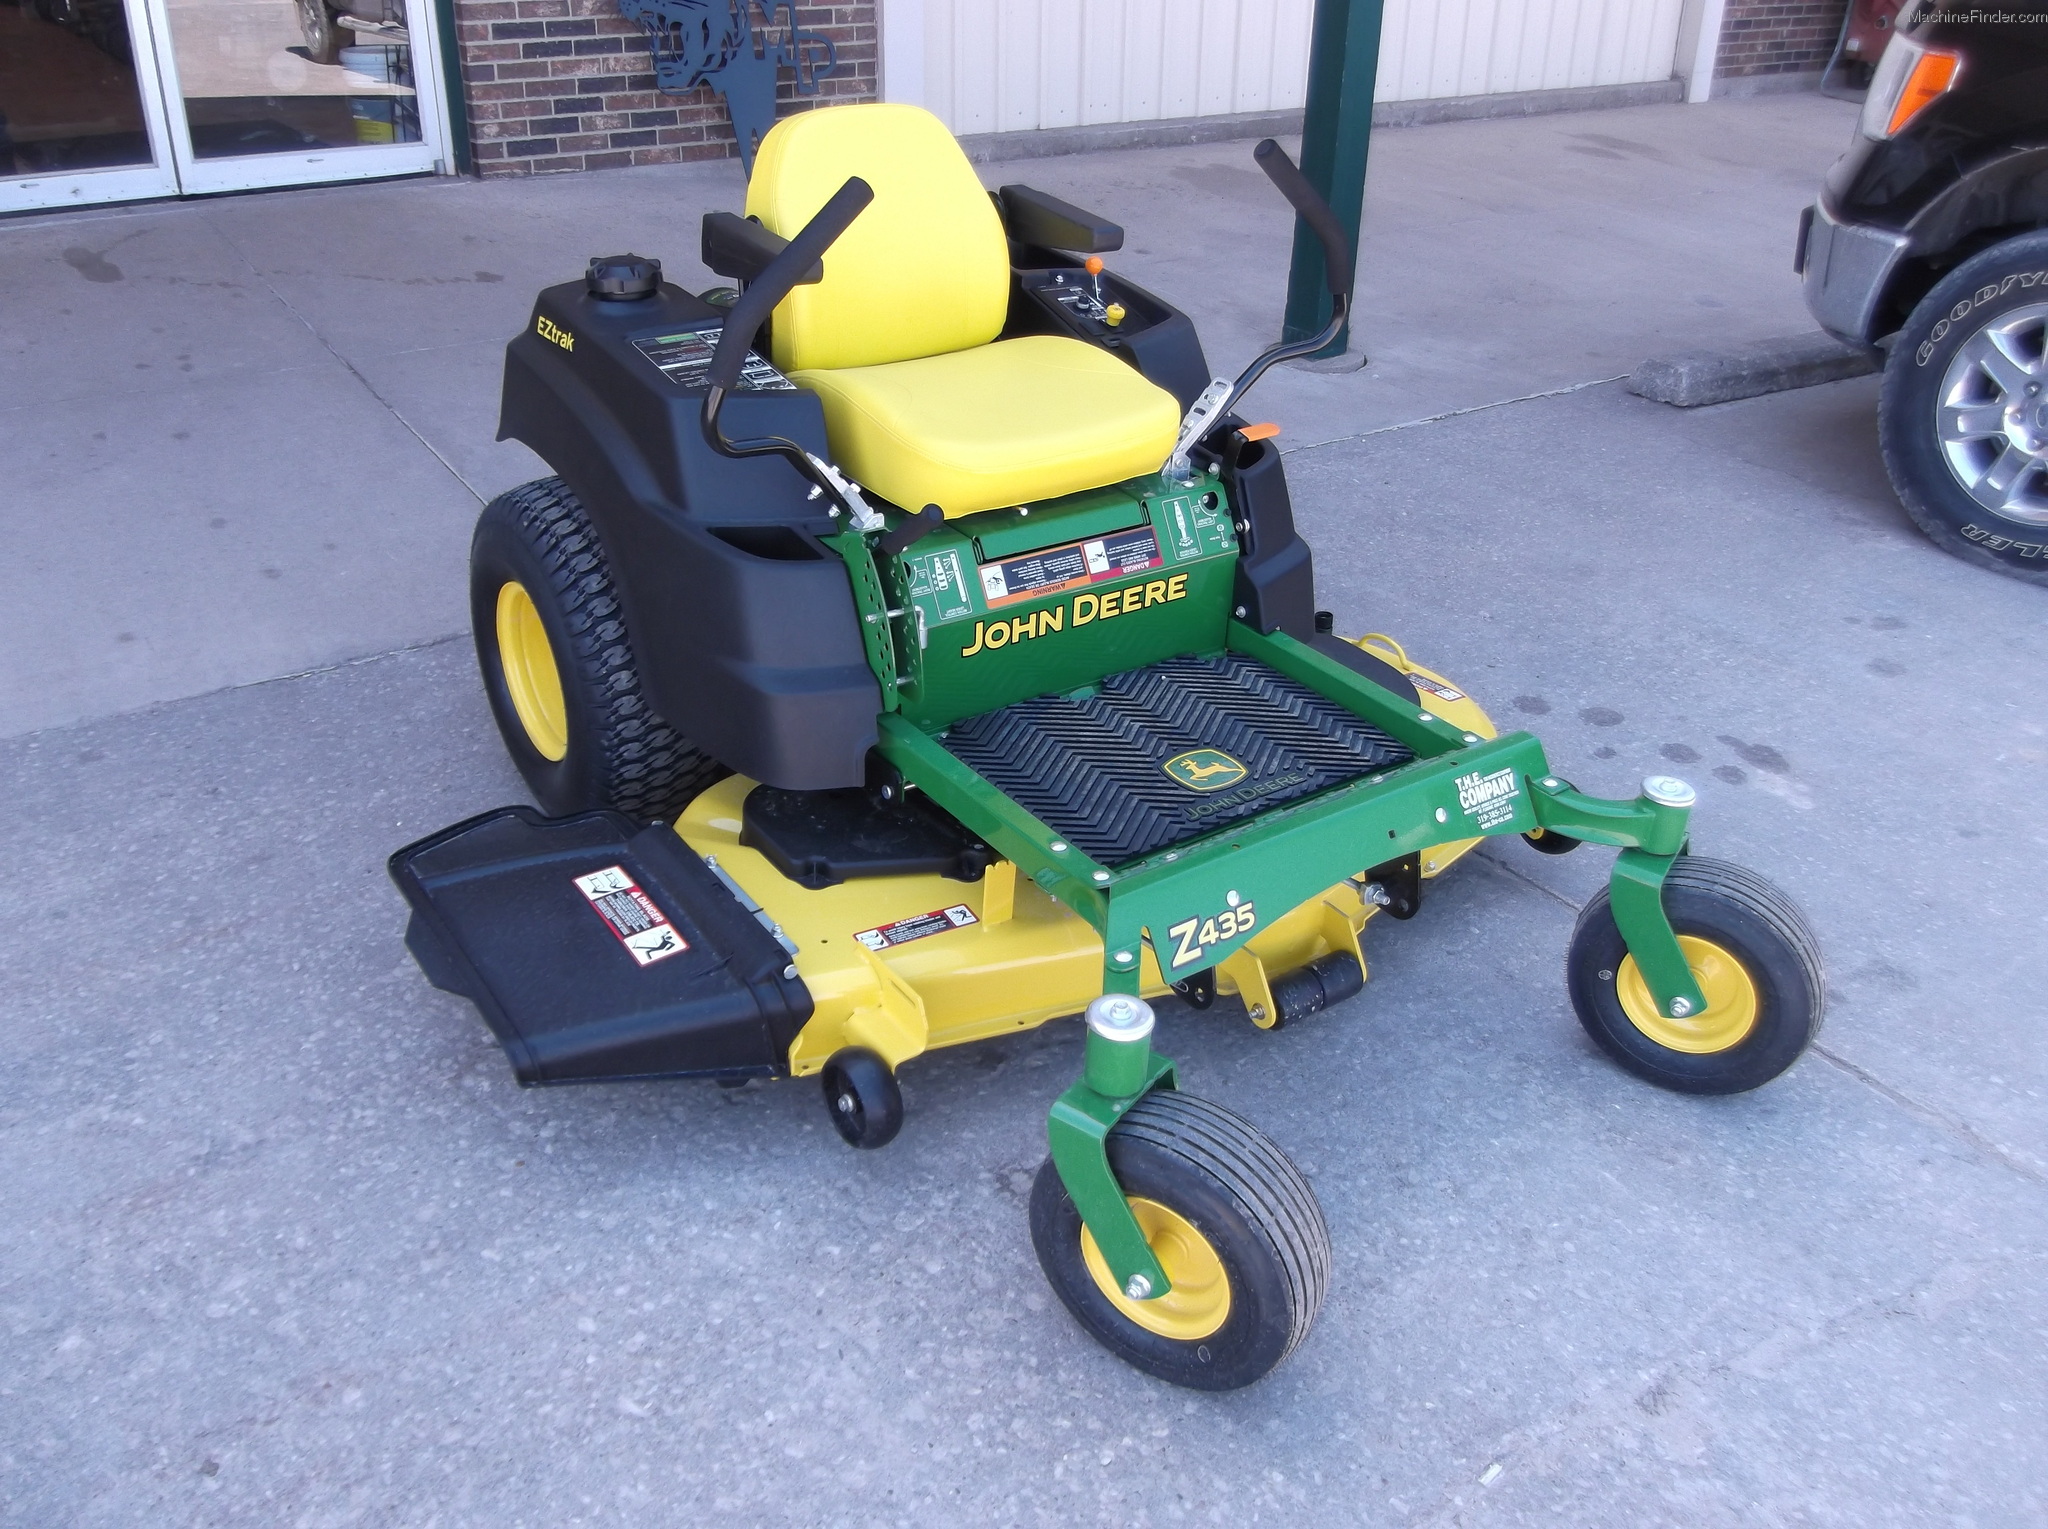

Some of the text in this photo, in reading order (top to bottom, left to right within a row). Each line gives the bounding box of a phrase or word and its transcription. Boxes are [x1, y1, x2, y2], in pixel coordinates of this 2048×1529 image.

[537, 315, 575, 353] EZtrak
[1122, 562, 1146, 574] DANGER
[1031, 583, 1062, 597] WARNING
[961, 605, 1064, 658] JOHN
[1072, 572, 1189, 628] DEERE
[1184, 773, 1307, 822] JOHN DEERE
[1459, 772, 1515, 809] COMPANY
[636, 895, 665, 924] DANGER
[899, 913, 930, 926] DANGER
[1168, 901, 1256, 969] Z435
